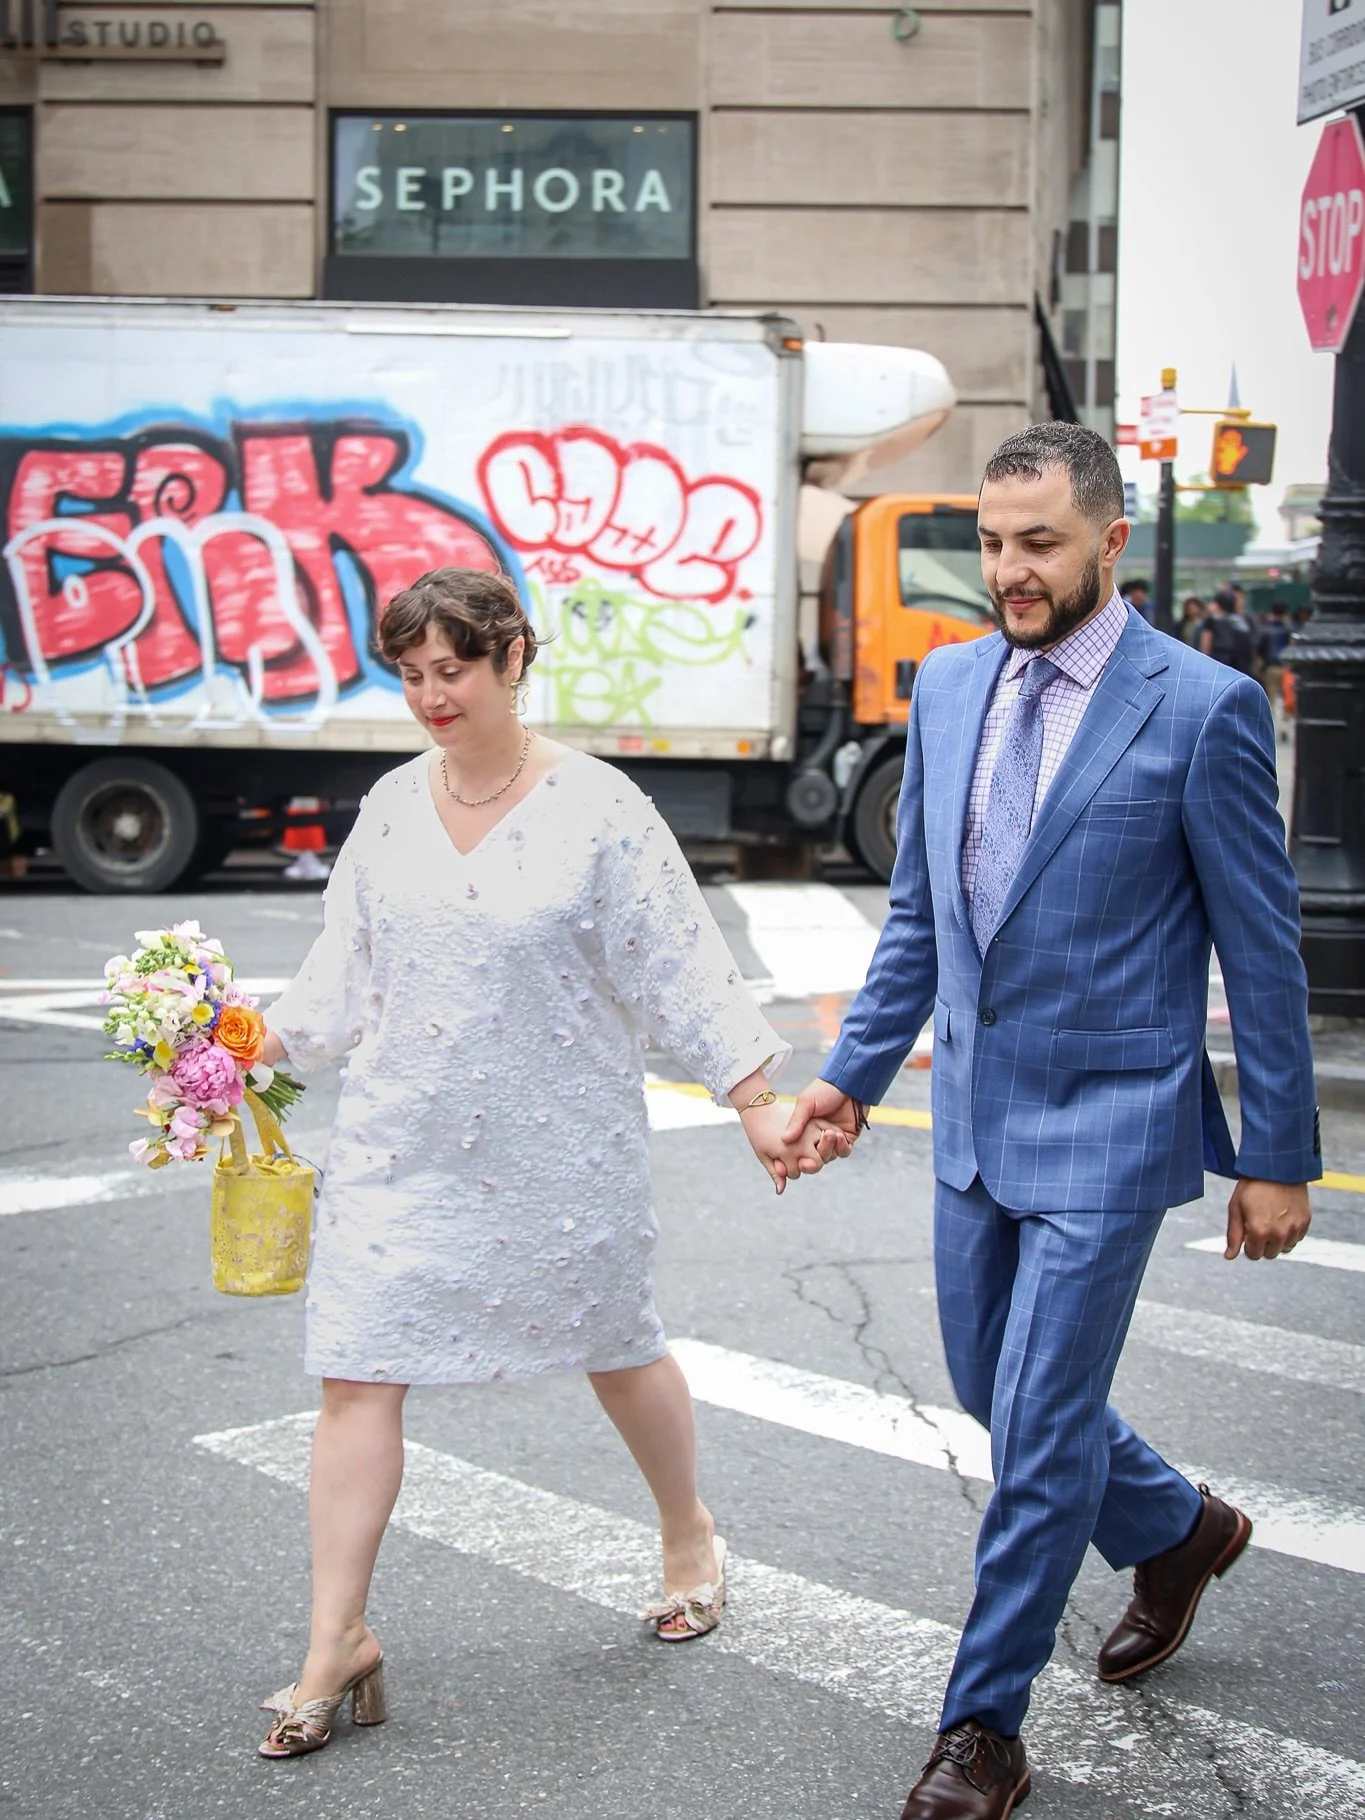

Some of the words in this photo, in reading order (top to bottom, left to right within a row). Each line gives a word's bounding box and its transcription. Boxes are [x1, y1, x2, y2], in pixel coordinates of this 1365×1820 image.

[65, 19, 217, 48] STUDIO
[355, 165, 673, 213] SEPHORA
[1299, 188, 1364, 281] STOP
